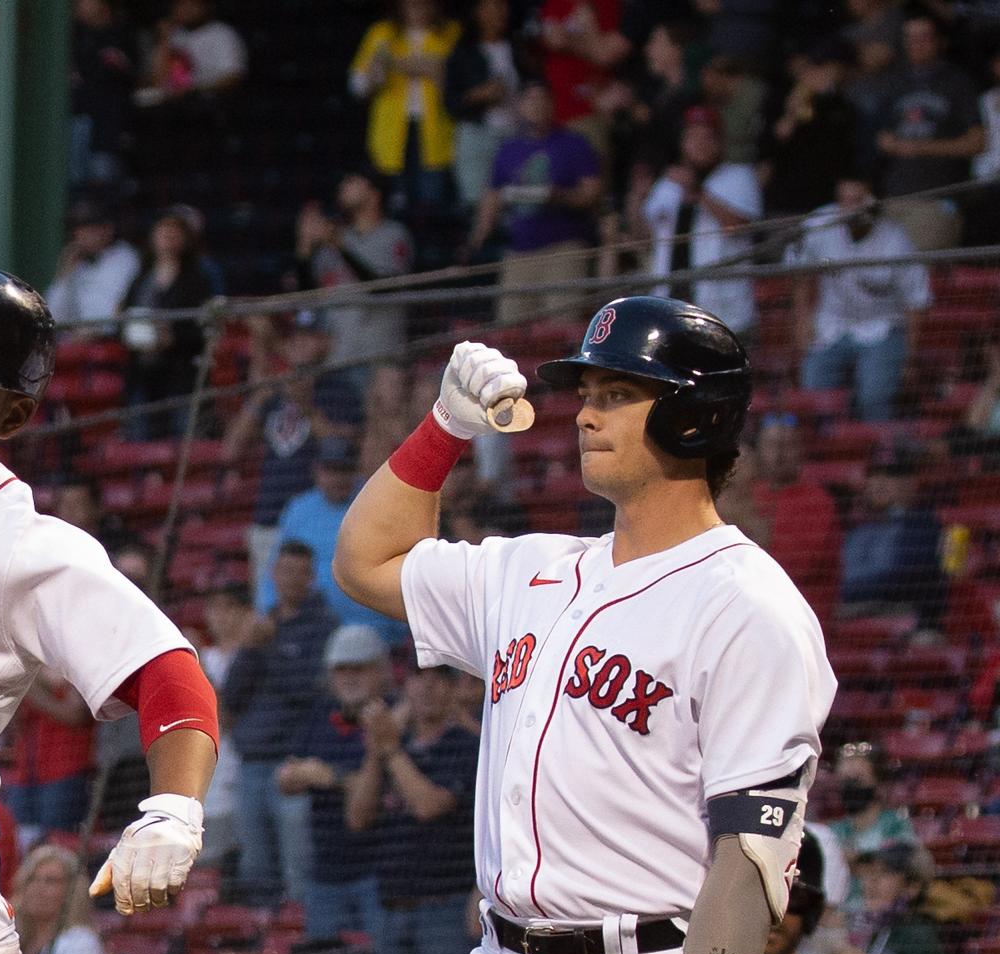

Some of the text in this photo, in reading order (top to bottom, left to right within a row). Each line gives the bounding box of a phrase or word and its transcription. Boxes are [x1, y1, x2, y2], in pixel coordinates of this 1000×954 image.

[589, 308, 616, 344] B
[563, 645, 674, 736] SOX
[760, 804, 784, 827] 29
